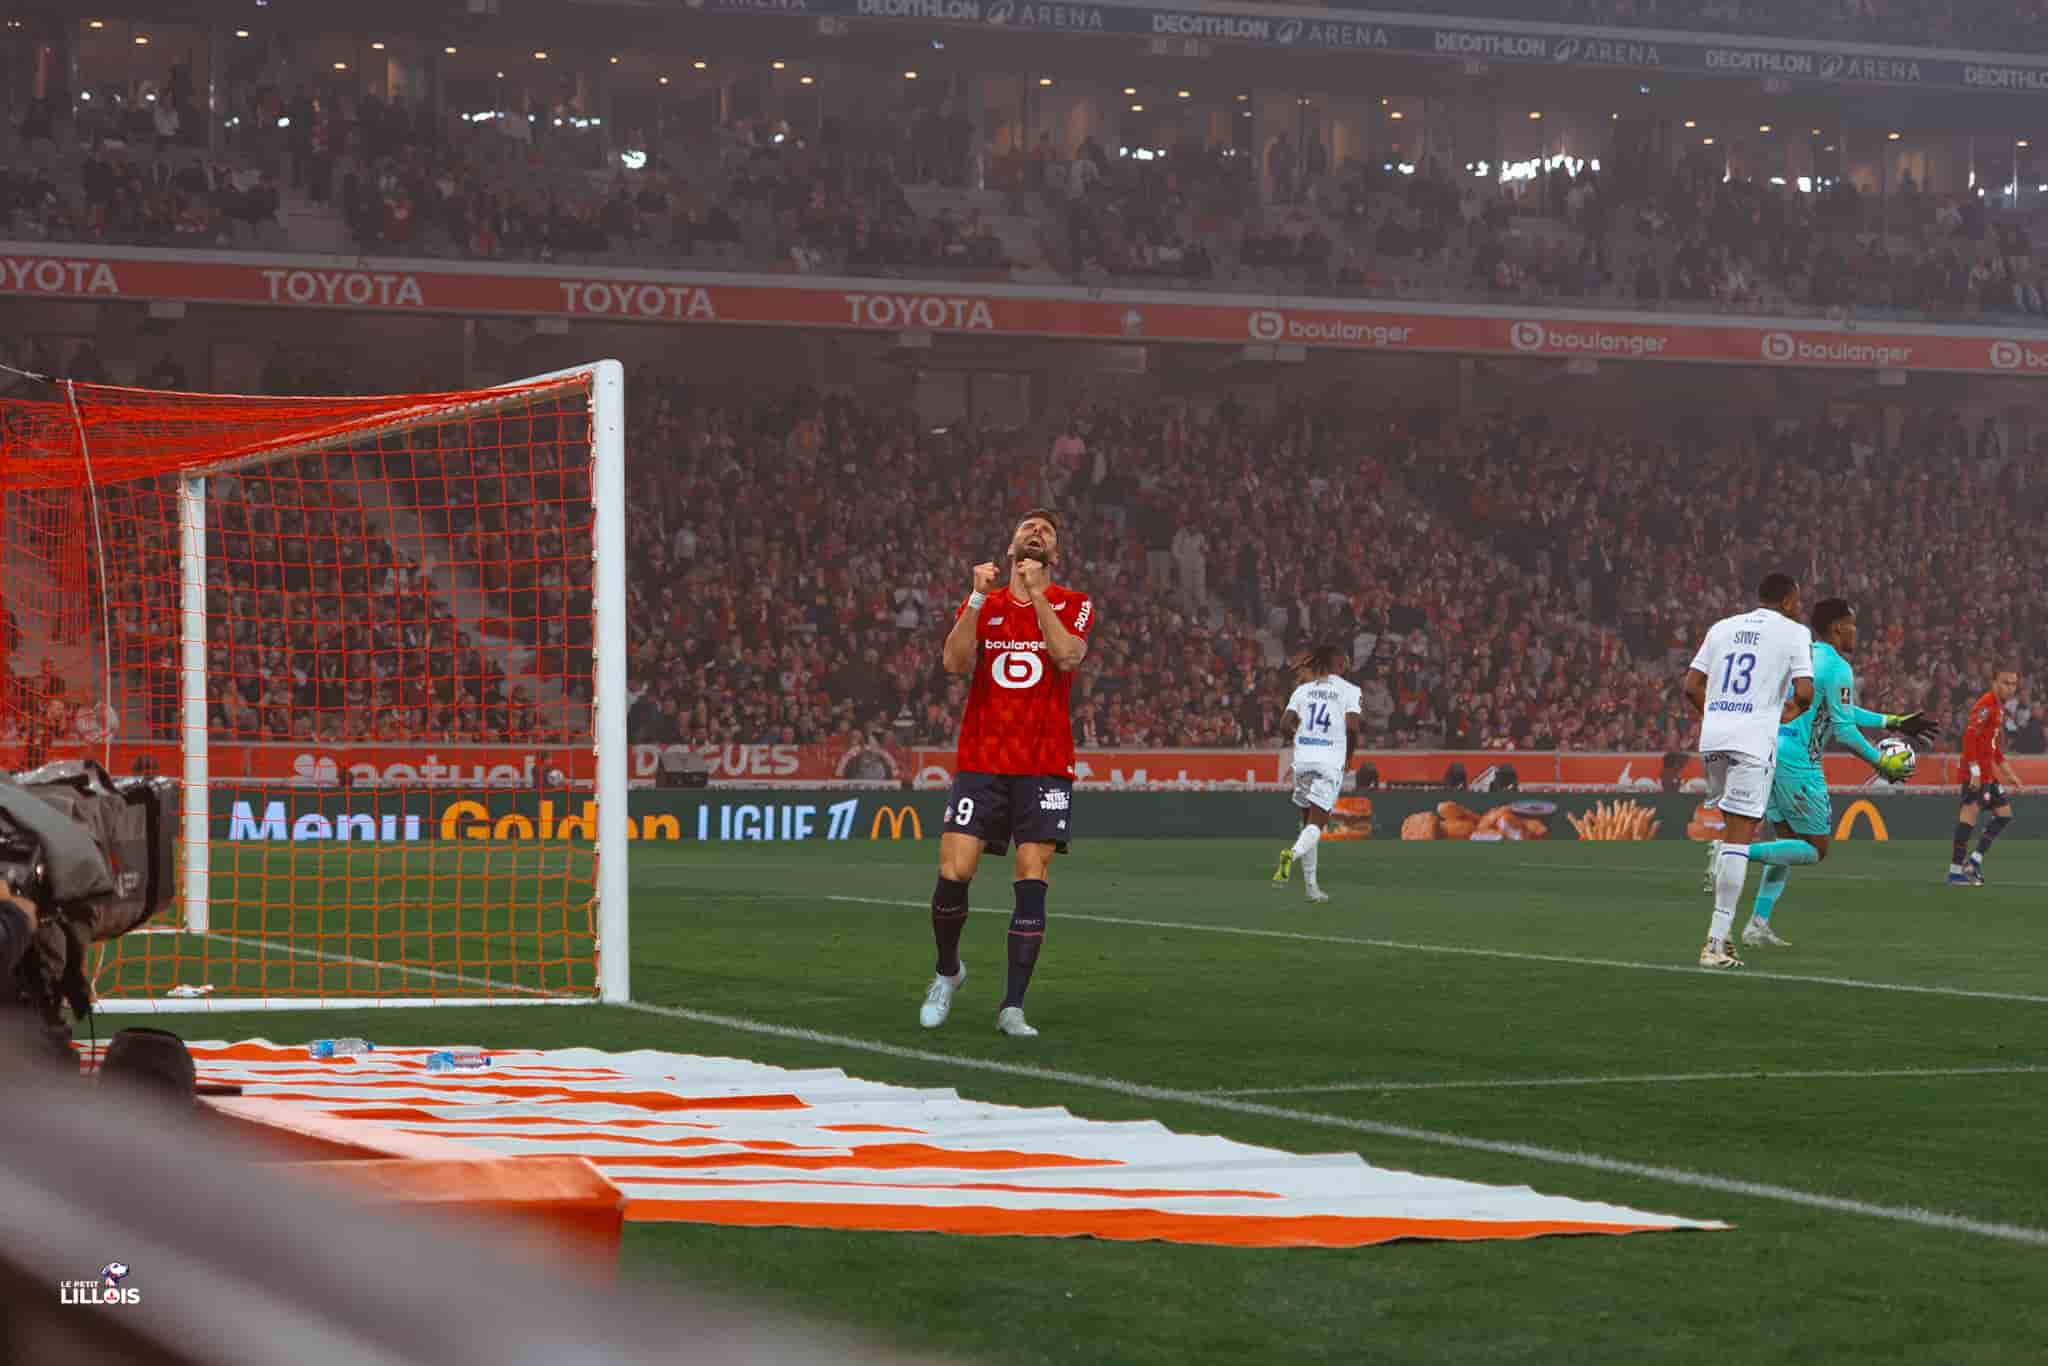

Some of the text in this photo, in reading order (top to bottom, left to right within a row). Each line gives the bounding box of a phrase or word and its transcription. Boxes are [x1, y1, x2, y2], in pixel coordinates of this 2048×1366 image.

[1021, 5, 1102, 29] ARENA
[1152, 15, 1389, 48] DECATHLON ARENA
[1434, 31, 1661, 65] DECATHLON ARENA
[1705, 49, 1921, 82] DECATHLON ARENA
[0, 258, 119, 294] YOTA
[262, 270, 424, 306] TOYOTA
[559, 281, 715, 320] TOYOTA
[845, 295, 993, 329] TOYOTA
[1289, 319, 1415, 345] boulanger
[1549, 328, 1668, 355] boulanger
[1798, 339, 1912, 365] boulanger
[985, 639, 1047, 651] boulange
[1722, 652, 1757, 695] 13
[1306, 702, 1332, 734] 14
[229, 800, 420, 841] Menu
[440, 799, 681, 841] Goldn
[955, 797, 975, 826] 9
